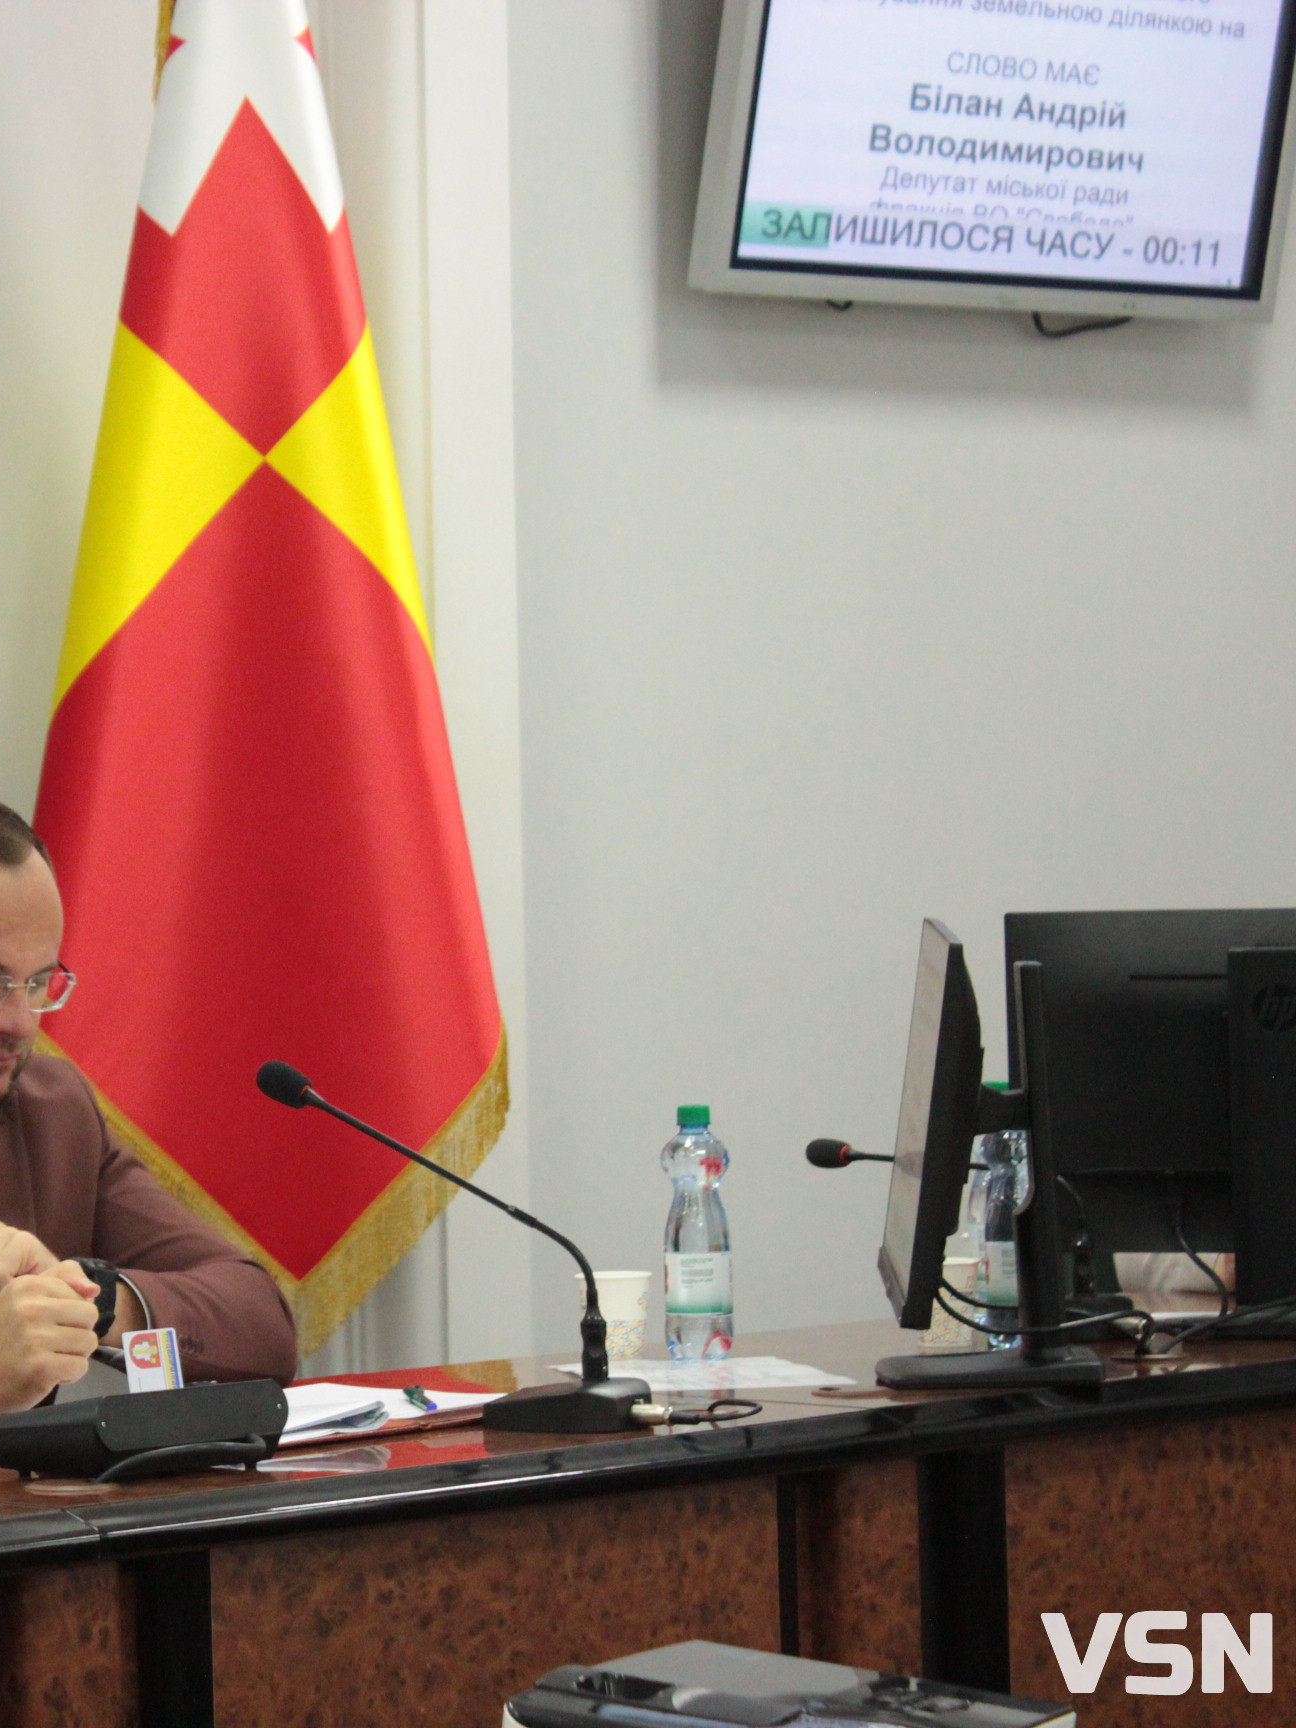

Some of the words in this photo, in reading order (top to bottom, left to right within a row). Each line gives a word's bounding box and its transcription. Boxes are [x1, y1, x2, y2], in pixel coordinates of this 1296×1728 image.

[1108, 6, 1212, 35] ділянкою
[1219, 19, 1245, 38] на
[947, 51, 1037, 80] СЛОВО
[1045, 60, 1100, 86] МАЄ
[910, 82, 1002, 118] Білан
[1013, 92, 1126, 132] Андрій
[869, 123, 1144, 173] Володимирович
[880, 165, 979, 196] Депутат
[986, 175, 1066, 199] міської
[1073, 184, 1128, 208] ради
[762, 209, 1014, 254] ЗАЛИШИЛОСЯ
[1027, 227, 1115, 261] ЧАСУ
[1143, 236, 1221, 267] 00:11
